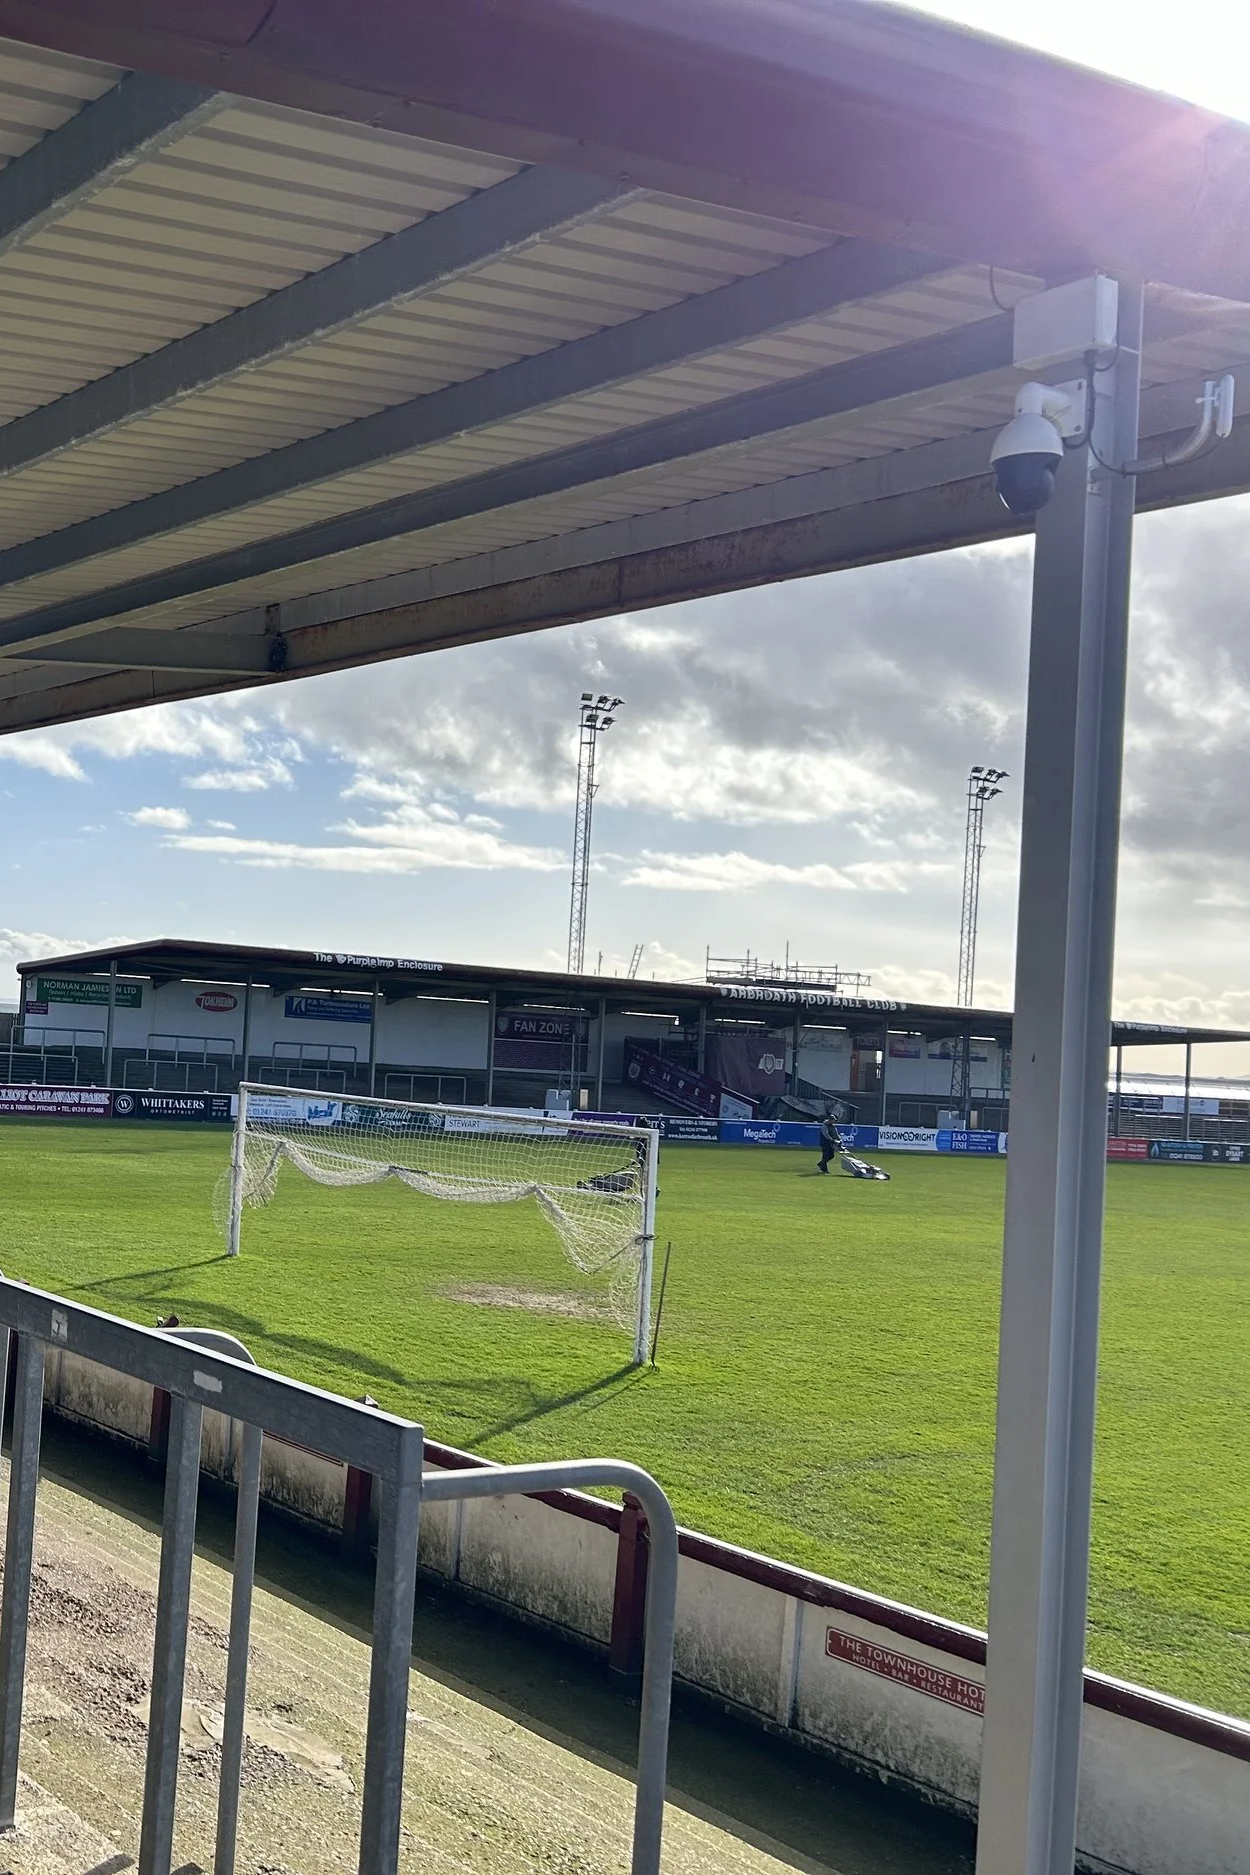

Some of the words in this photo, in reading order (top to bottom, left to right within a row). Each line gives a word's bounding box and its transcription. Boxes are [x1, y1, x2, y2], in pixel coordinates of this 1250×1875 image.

[313, 953, 333, 963] The
[397, 960, 443, 971] Enclosure
[43, 981, 80, 990] NORMAN
[82, 984, 122, 993] JAMIESN
[123, 986, 137, 994] LTD
[729, 987, 797, 1003] ARBROATH
[801, 993, 862, 1009] FOOTBALL
[867, 1000, 897, 1011] CLUB
[514, 1020, 536, 1033] FAN
[539, 1022, 569, 1035] ZONE
[28, 1090, 80, 1103] CARAVAN
[80, 1091, 110, 1105] PARK
[141, 1098, 205, 1109] WHITTAKERS
[120, 1100, 129, 1108] W
[450, 1119, 480, 1128] STEWART
[743, 1128, 777, 1140] MegaTech
[914, 1132, 936, 1142] RIGHT
[952, 1132, 967, 1141] E&O
[952, 1141, 967, 1150] FISH
[838, 1635, 862, 1654] THE
[866, 1646, 953, 1690] TOWNHOUSE
[852, 1652, 880, 1671] HOTEL
[891, 1668, 910, 1682] BAR
[920, 1681, 985, 1711] RESTAURANT
